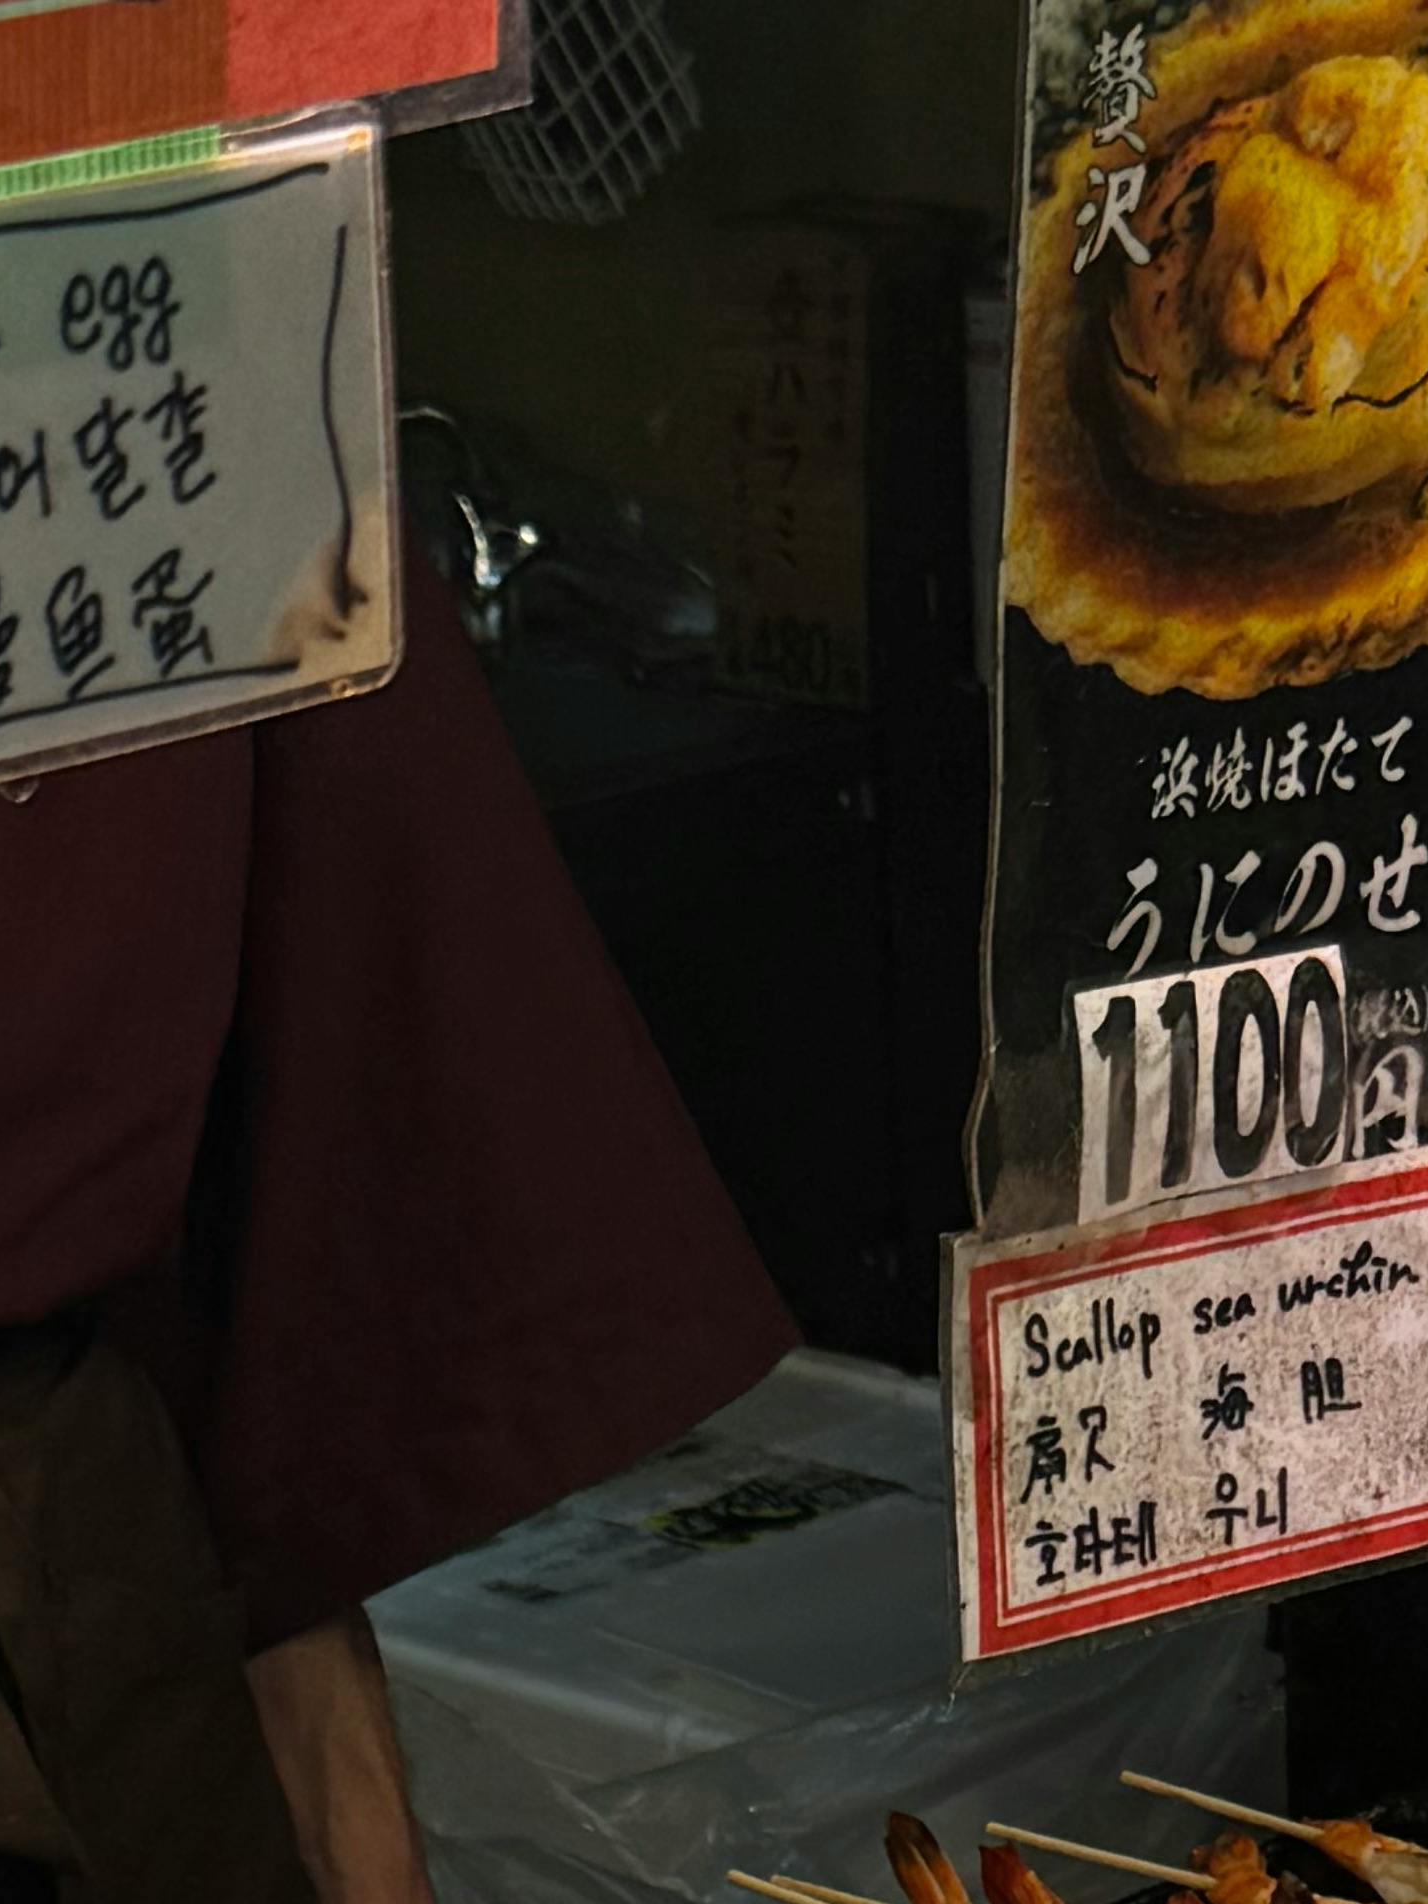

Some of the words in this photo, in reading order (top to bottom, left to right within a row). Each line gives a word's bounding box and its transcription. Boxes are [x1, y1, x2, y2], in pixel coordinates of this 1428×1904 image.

[1072, 24, 1157, 275] 贅沢
[60, 255, 181, 371] egg
[1151, 715, 1413, 819] 浜焼ほたて
[1106, 814, 1428, 979] うにのせ
[1092, 956, 1347, 1206] 1100
[1352, 1044, 1424, 1158] 円
[1025, 1297, 1161, 1379] Scallop
[1193, 1293, 1256, 1334] sea
[1278, 1241, 1419, 1311] urchin
[1206, 1466, 1288, 1544] 우니
